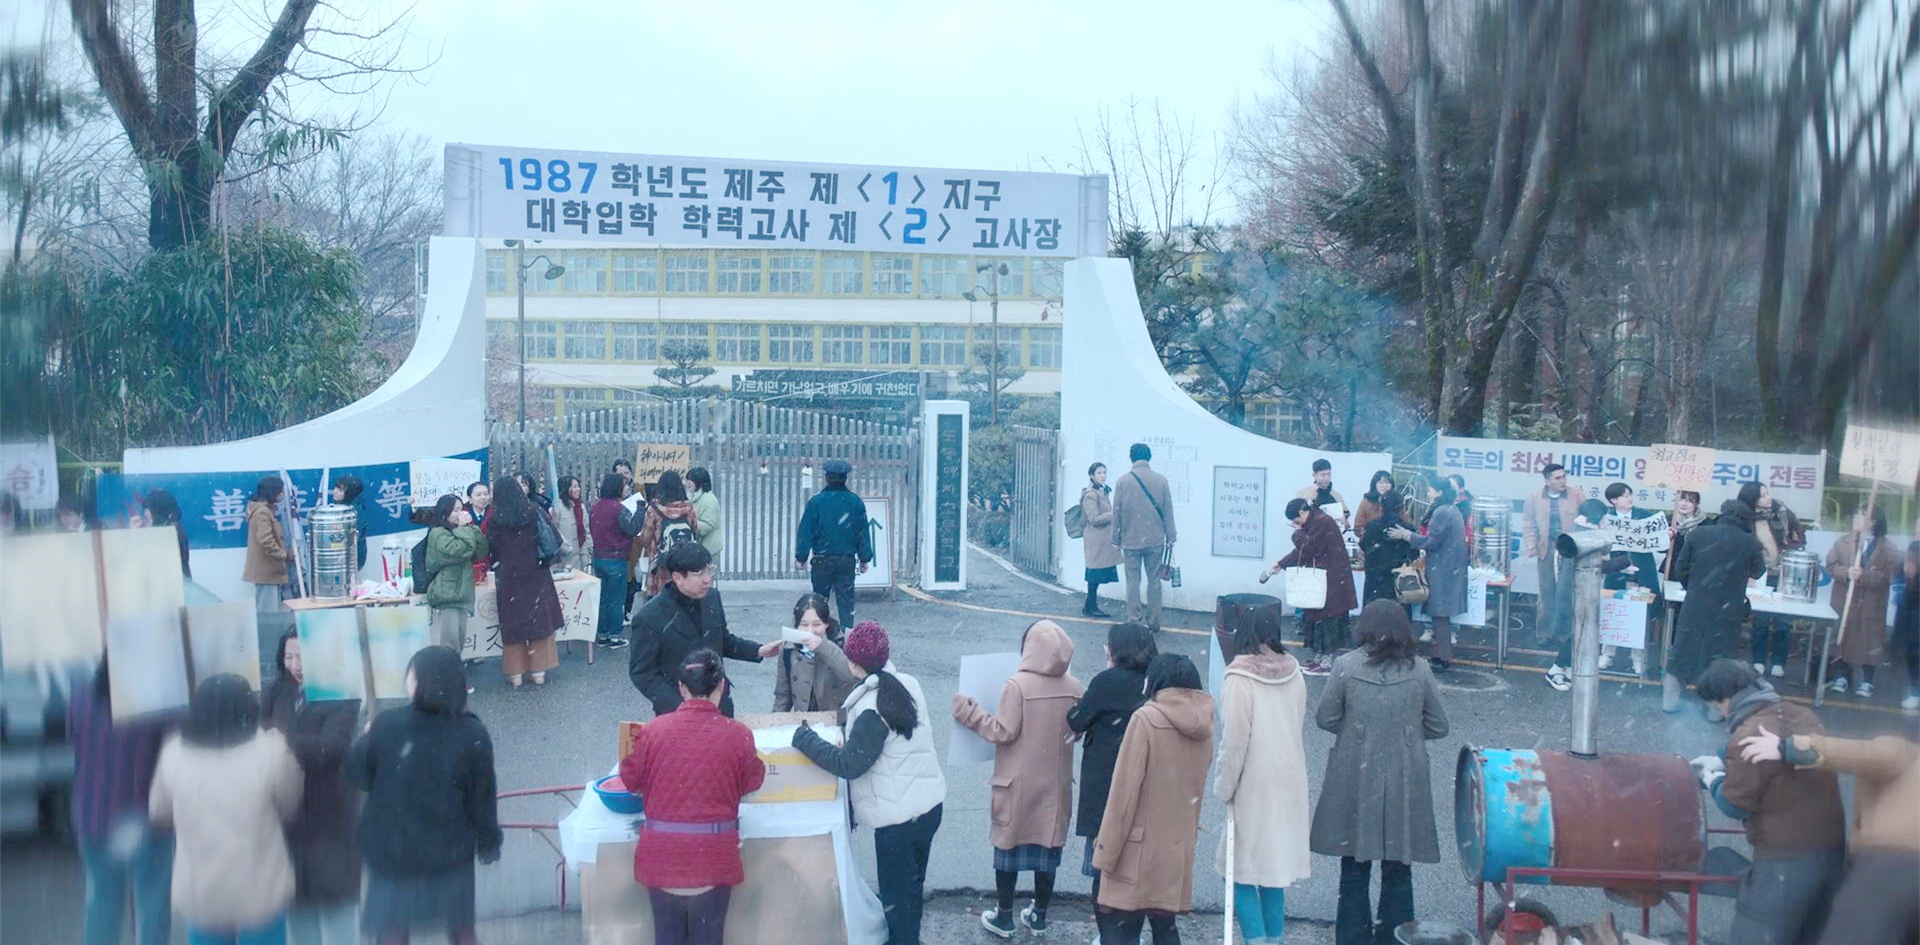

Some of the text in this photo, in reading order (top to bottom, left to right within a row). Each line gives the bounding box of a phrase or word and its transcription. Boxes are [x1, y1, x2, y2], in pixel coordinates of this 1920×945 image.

[499, 158, 598, 194] 1987
[611, 163, 708, 199] 학년도
[724, 168, 785, 202] 제주
[810, 173, 838, 204] 제
[943, 178, 1001, 211] 지구
[526, 198, 657, 236] 대학입학
[682, 205, 810, 242] 학력고사
[828, 211, 856, 244] 제
[972, 217, 1061, 250] 고사장
[1443, 448, 1503, 471] 오늘의
[1511, 451, 1553, 473] 최선
[1560, 453, 1626, 479] 내일의
[1712, 462, 1760, 486] 주의
[1769, 465, 1817, 489] 전통
